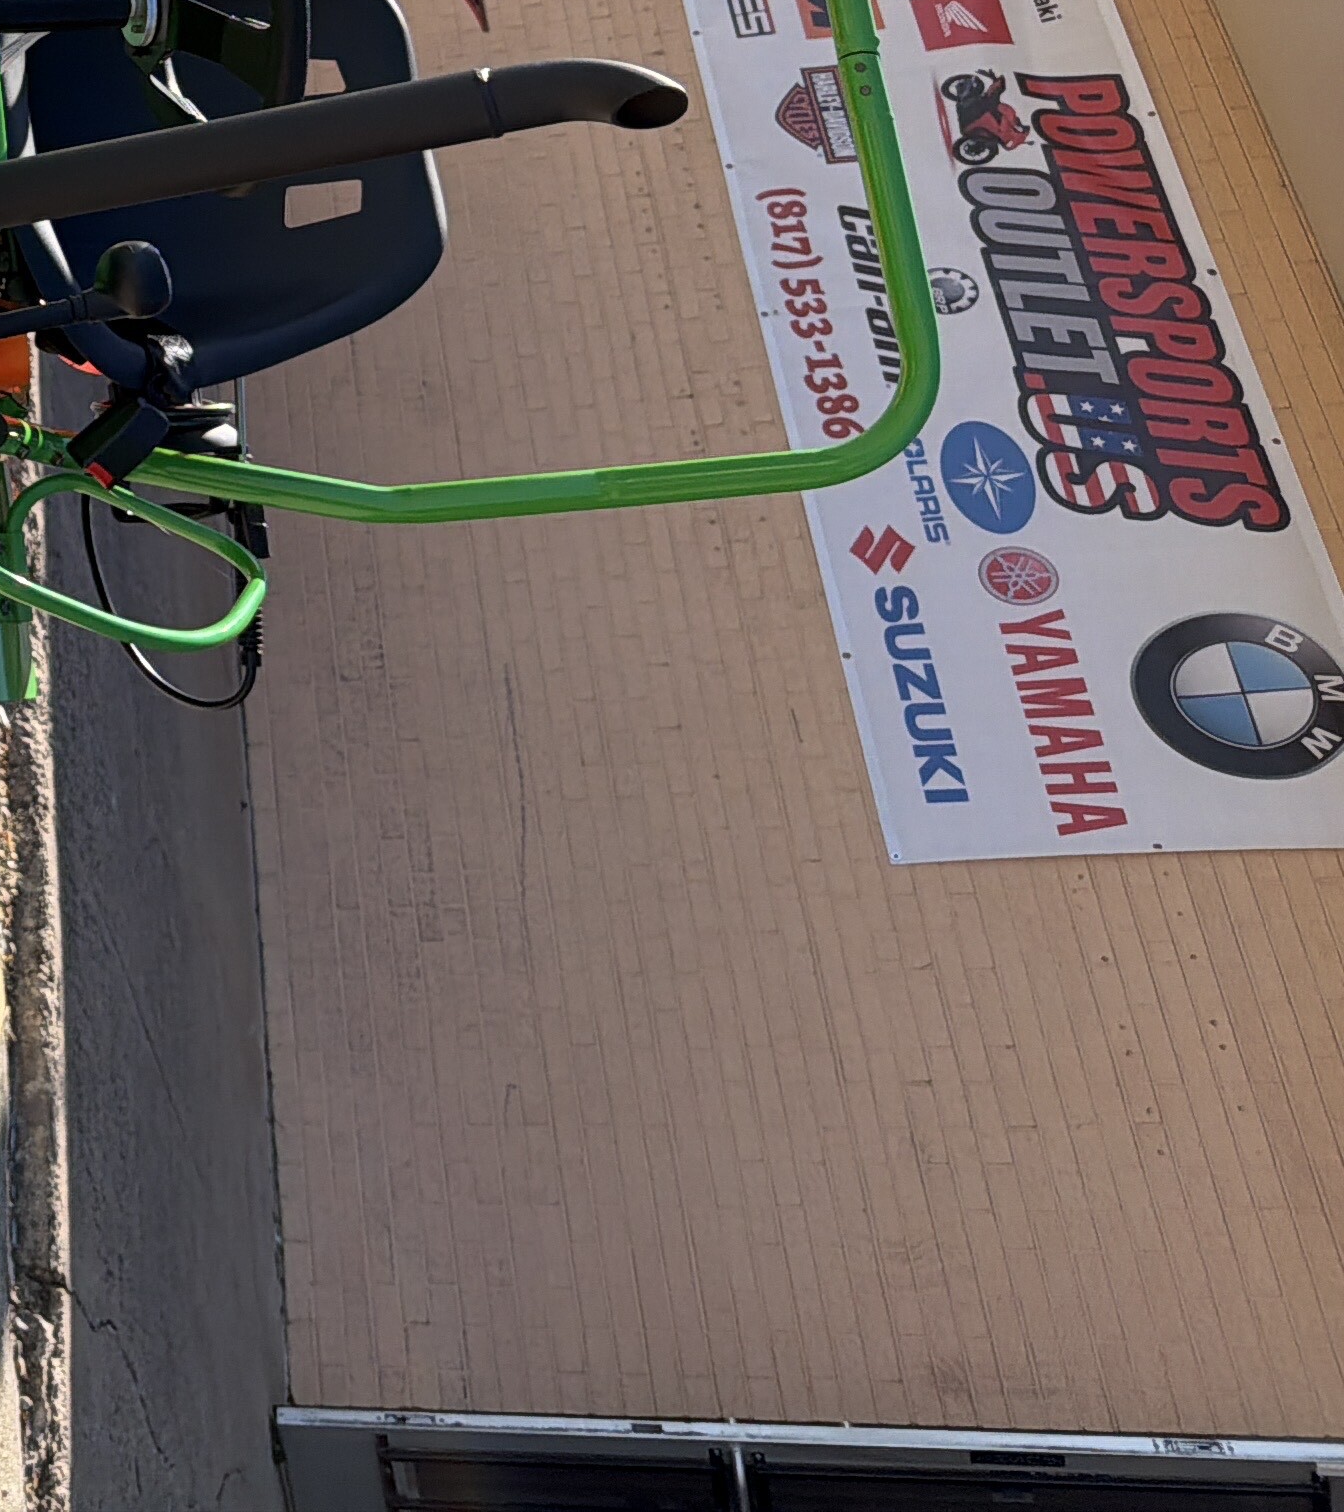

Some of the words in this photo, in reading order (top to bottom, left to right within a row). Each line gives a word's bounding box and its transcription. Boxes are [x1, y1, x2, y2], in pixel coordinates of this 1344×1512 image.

[934, 3, 952, 39] HONDA
[783, 93, 822, 146] CYCLES
[812, 72, 860, 158] HARLEY-DAVIDSON
[755, 188, 824, 270] (817)
[778, 277, 866, 439] 533-1386
[965, 171, 1161, 514] OUTLET.US
[1023, 77, 1283, 526] POWERSPORTS
[903, 438, 950, 543] OLARIS
[874, 585, 970, 804] SUZUKI
[999, 609, 1128, 837] YAMAHA
[1264, 624, 1344, 760] BMW
